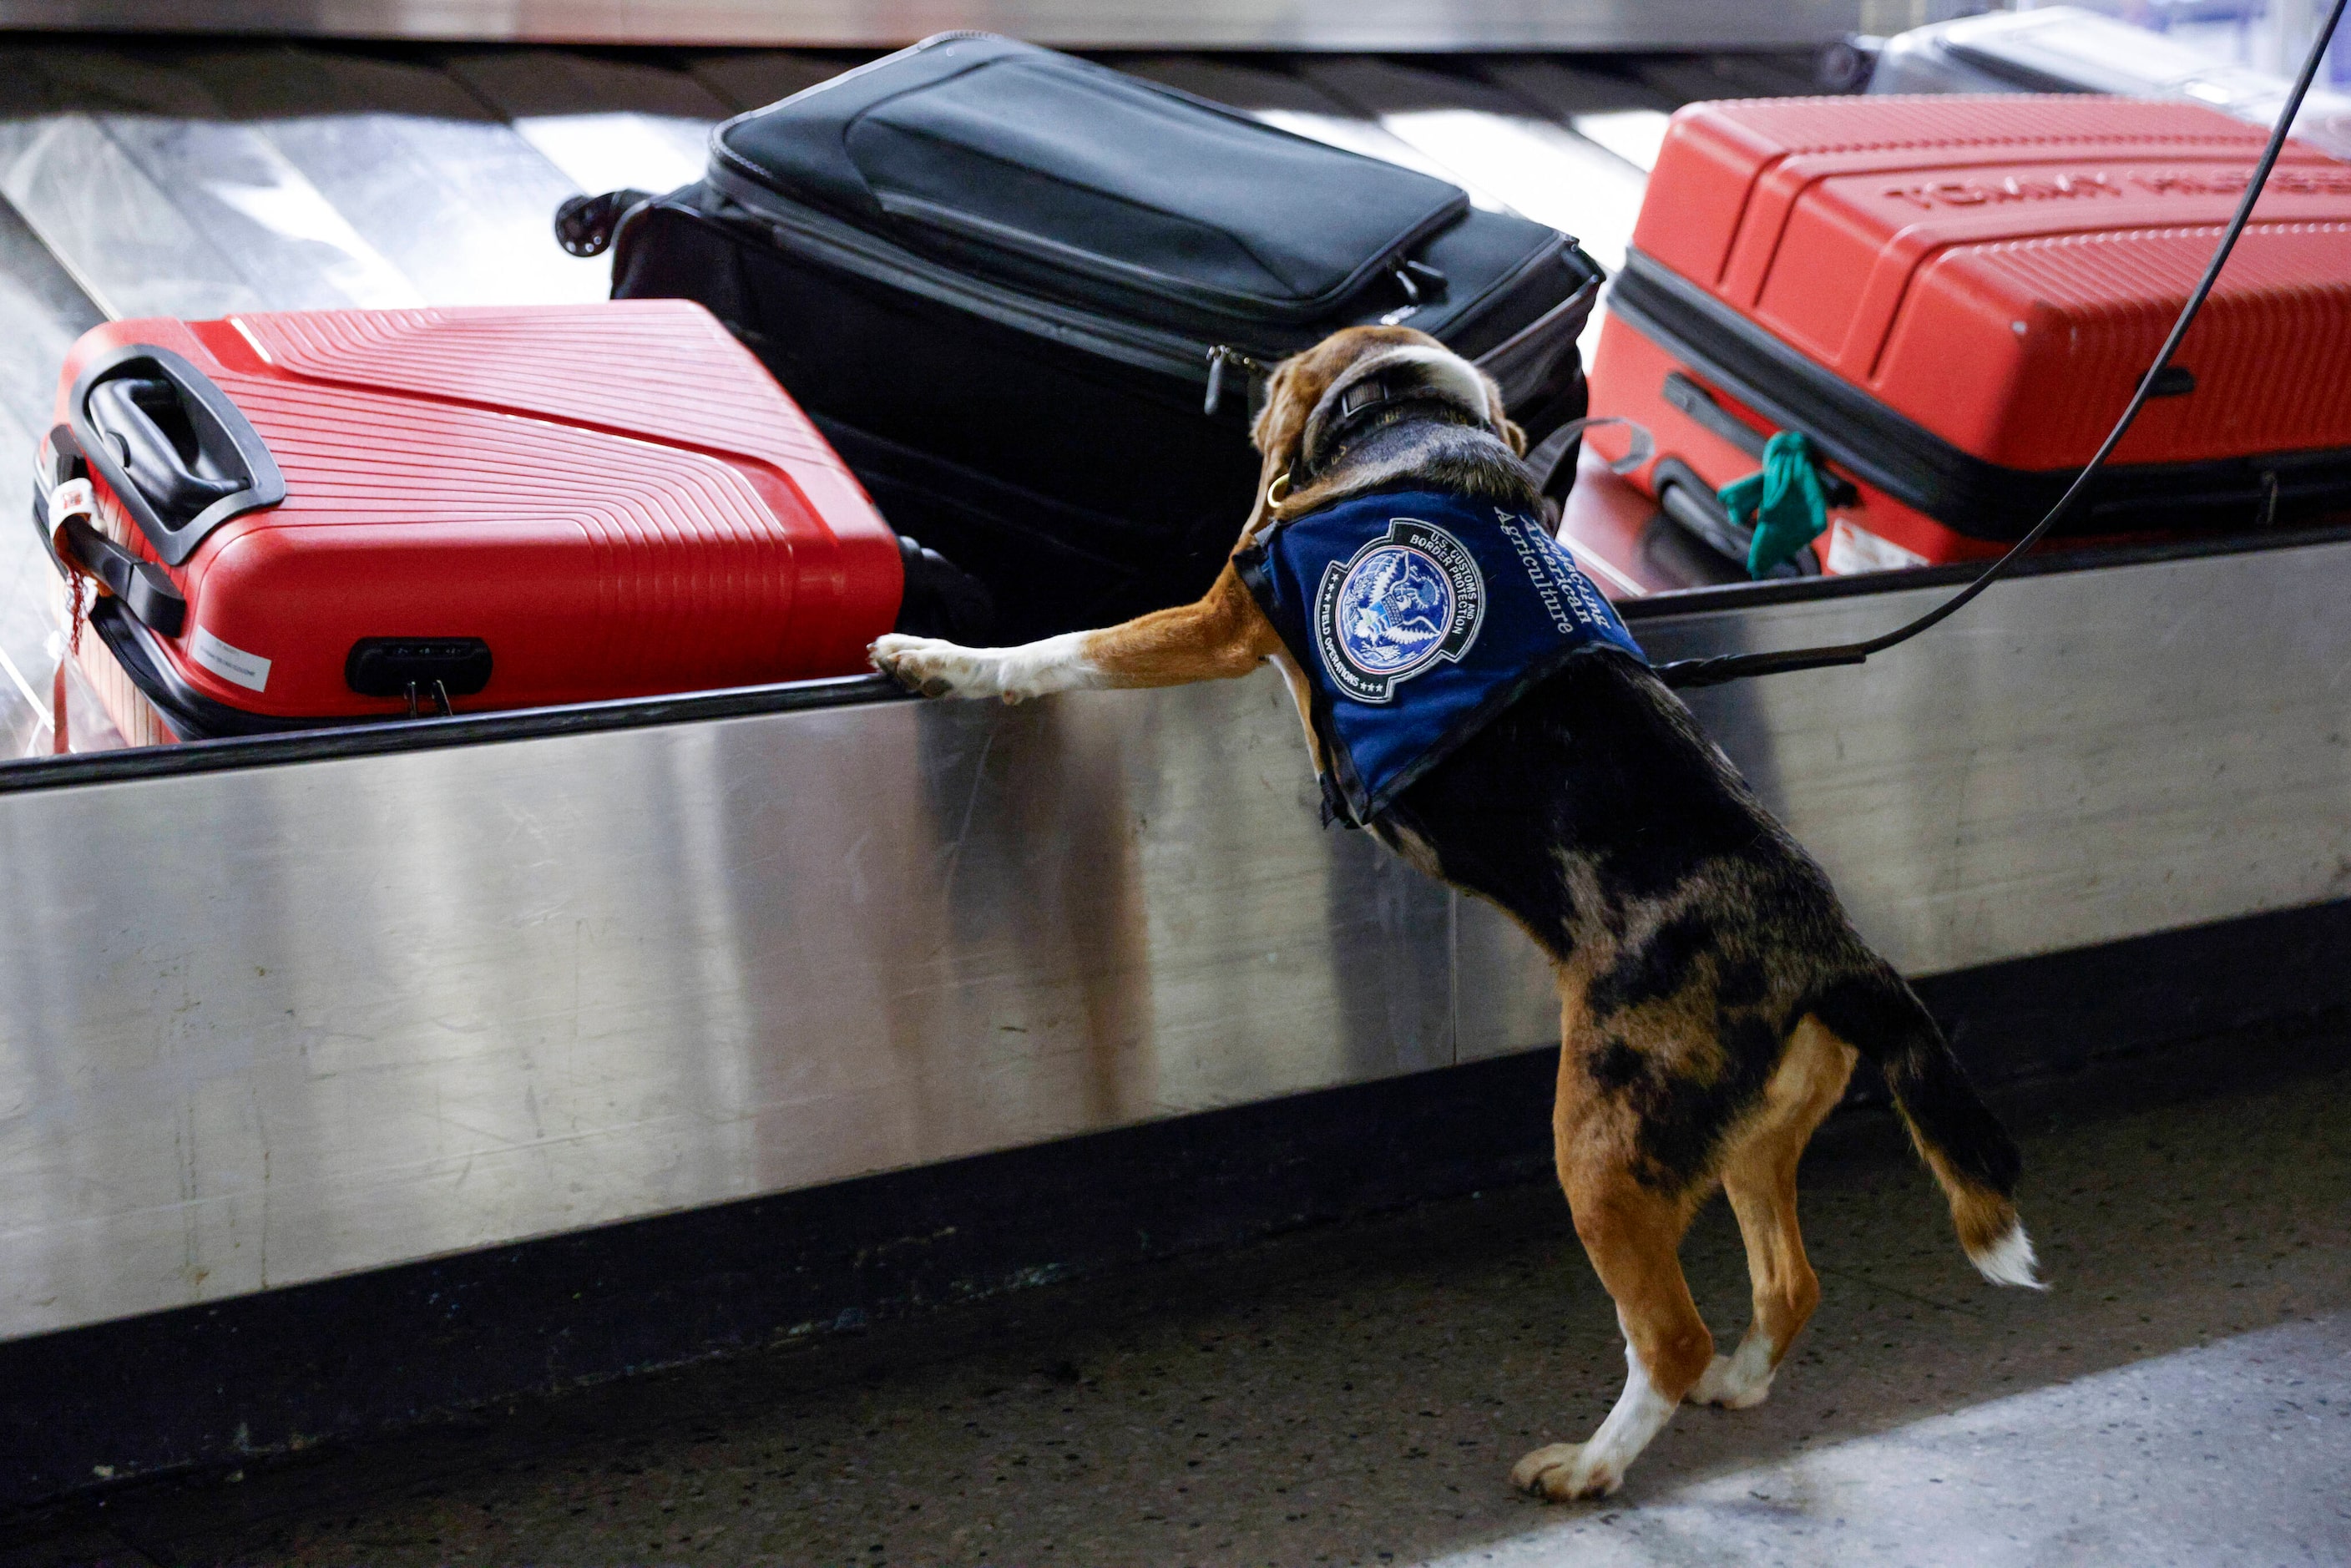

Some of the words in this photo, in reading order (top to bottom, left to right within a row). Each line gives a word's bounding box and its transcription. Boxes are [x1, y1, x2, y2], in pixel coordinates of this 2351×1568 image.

[1409, 534, 1453, 567] BORDER
[1449, 566, 1469, 635] PROTECTION
[1430, 531, 1449, 551] U.S.
[1449, 549, 1477, 600] CUSTOMS
[1466, 603, 1476, 620] AND
[1493, 505, 1574, 635] Agriculture
[1519, 513, 1592, 624] American
[1321, 604, 1331, 635] FIELD
[1324, 637, 1360, 687] OPERATIONS
